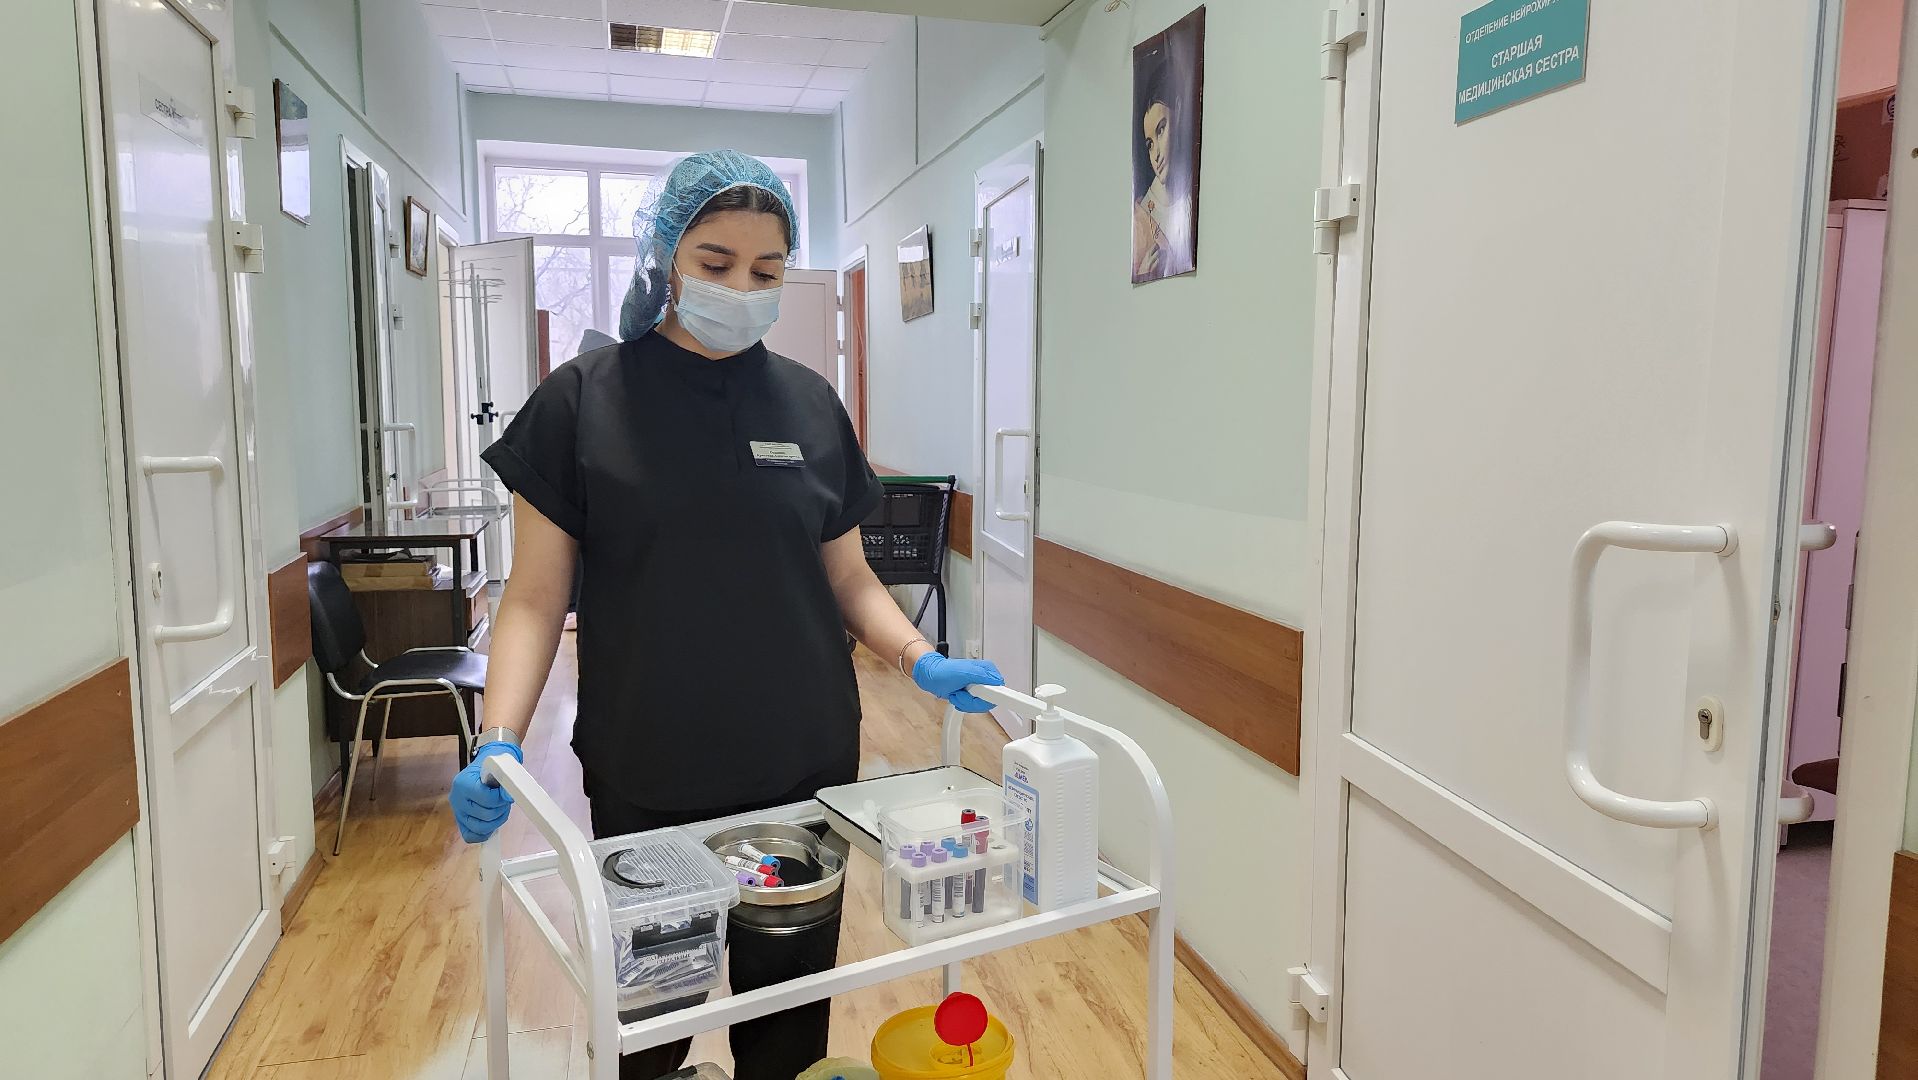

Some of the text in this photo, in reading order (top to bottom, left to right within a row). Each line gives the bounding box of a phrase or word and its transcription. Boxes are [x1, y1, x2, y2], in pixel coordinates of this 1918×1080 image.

[1465, 14, 1509, 44] ОТДЕЛЕНИЕ
[1491, 34, 1543, 69] СТАРШАЯ
[1458, 45, 1580, 105] МЕДИЦИНСКАЯ СЕСТРА
